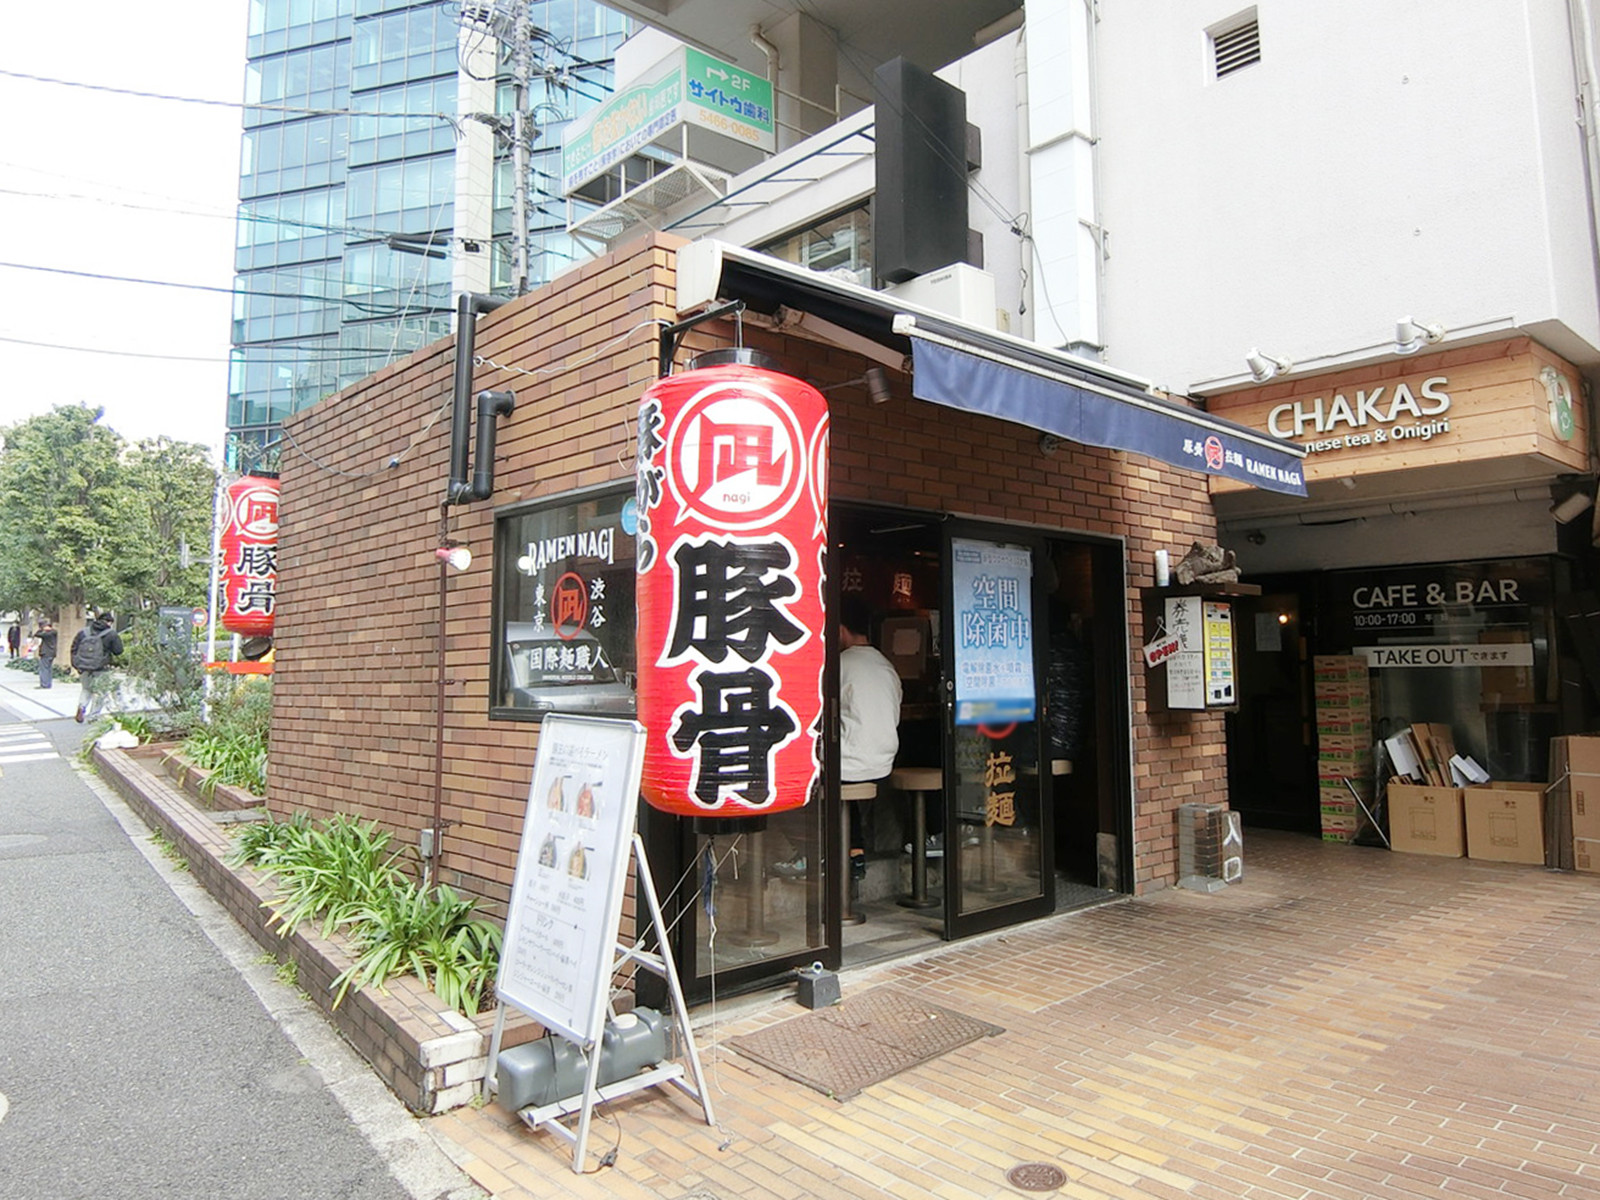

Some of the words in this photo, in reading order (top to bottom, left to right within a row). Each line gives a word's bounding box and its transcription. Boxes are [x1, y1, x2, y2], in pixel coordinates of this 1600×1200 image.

[688, 78, 770, 124] サイトウ歯科
[731, 74, 751, 91] 2F
[1268, 376, 1451, 439] CHAKAS
[1345, 429, 1371, 447] tea
[1374, 428, 1388, 443] &
[1391, 417, 1450, 442] Onigiri
[1246, 458, 1277, 481] RAMEN
[1277, 469, 1302, 486] NAGI
[723, 491, 752, 505] nagi
[527, 533, 576, 576] RAMEN
[577, 527, 615, 565] NAGI
[237, 545, 278, 615] 豚骨
[973, 574, 1019, 612] 空間
[1353, 584, 1418, 608] CAFE
[1426, 582, 1446, 606] &
[1456, 579, 1519, 603] BAR
[533, 583, 548, 633] 東京
[590, 577, 607, 628] 渋谷
[1353, 612, 1416, 626] 10:00-17:00
[962, 611, 1029, 649] 除菌中
[529, 645, 609, 672] 国際麺職人
[662, 537, 808, 806] 豚骨
[1373, 649, 1422, 665] TAKE
[1426, 648, 1468, 664] OUT
[1470, 650, 1508, 661] できます
[984, 750, 1016, 827] 拉麺
